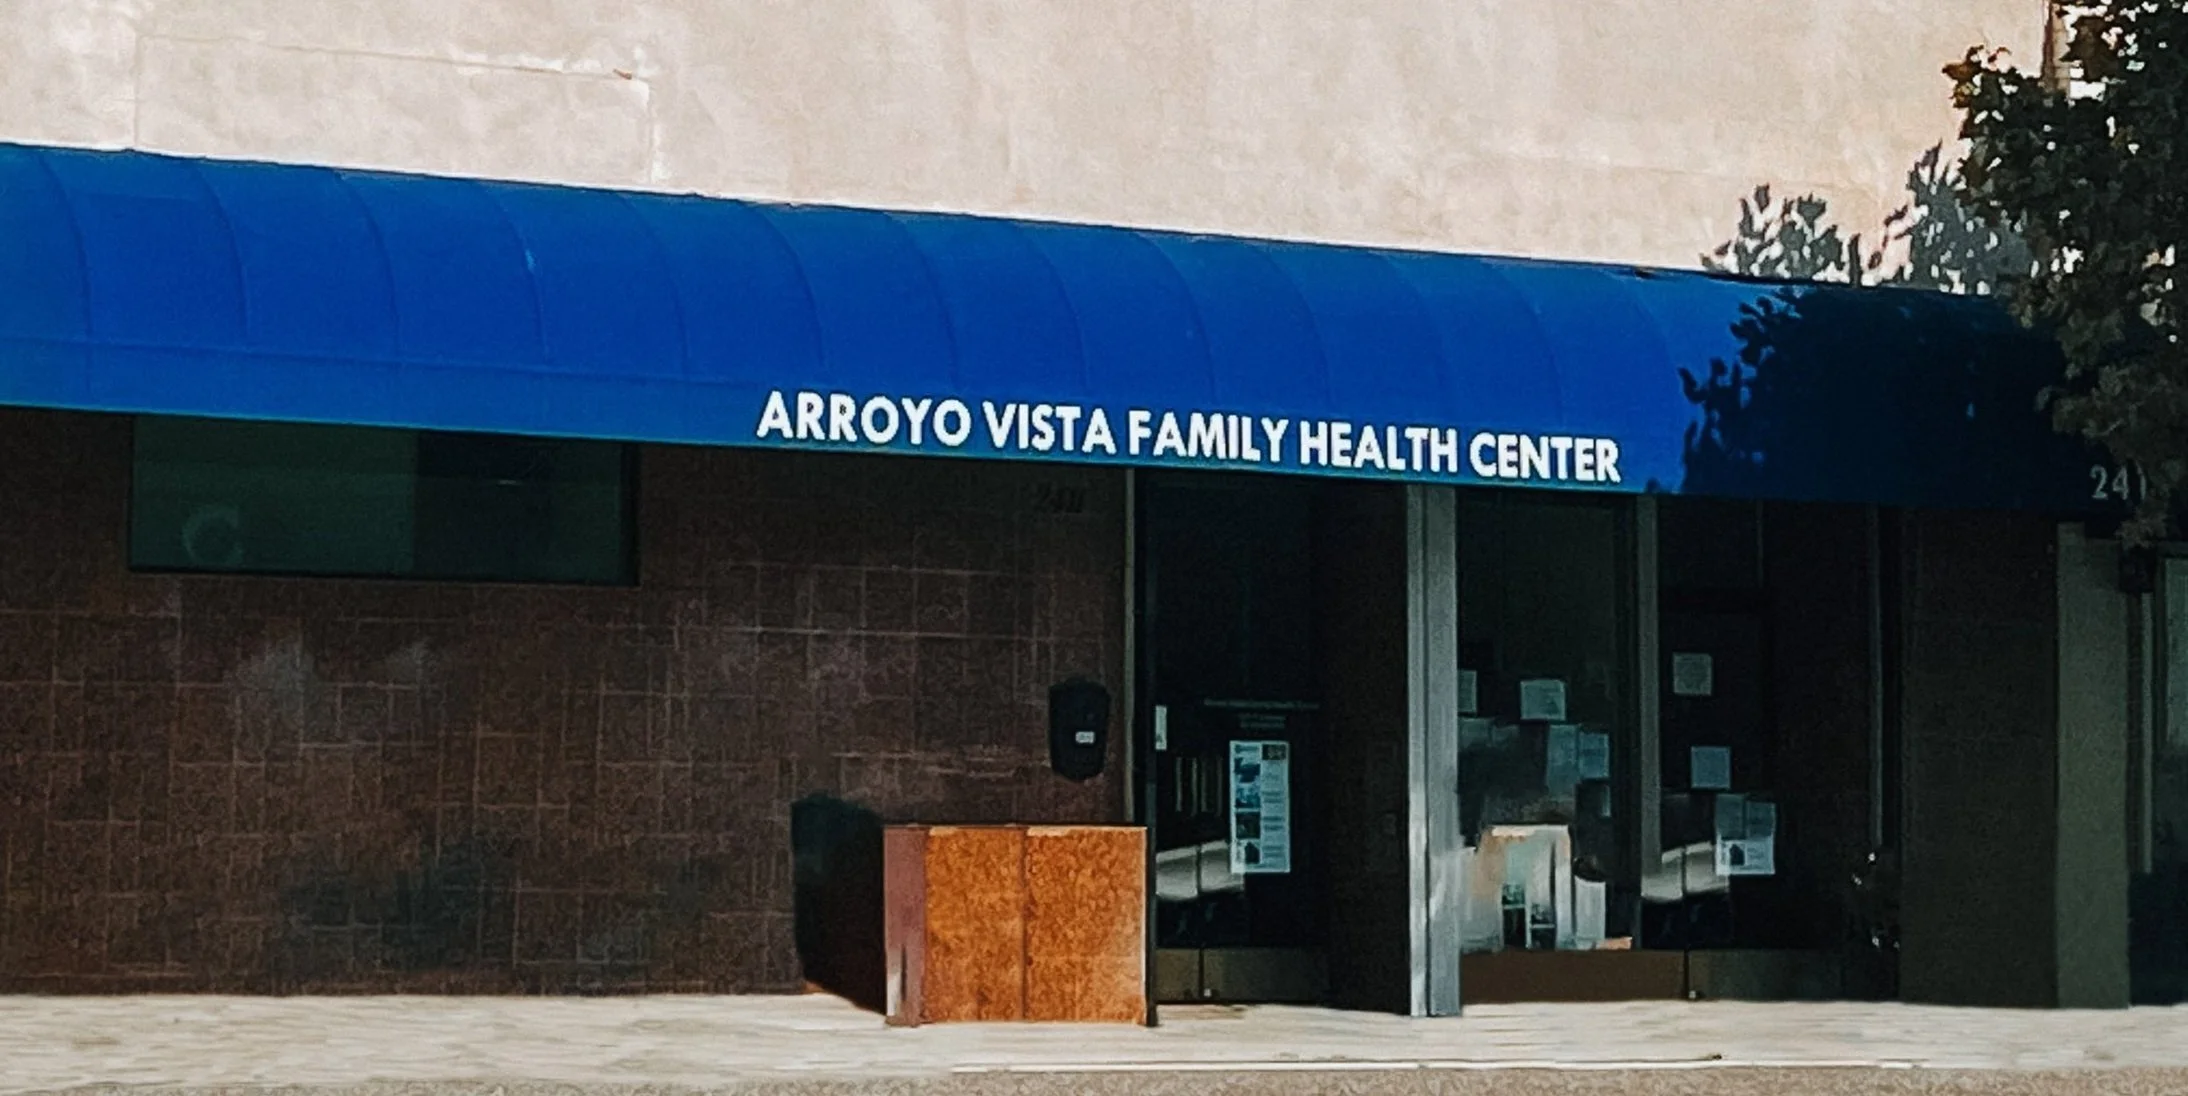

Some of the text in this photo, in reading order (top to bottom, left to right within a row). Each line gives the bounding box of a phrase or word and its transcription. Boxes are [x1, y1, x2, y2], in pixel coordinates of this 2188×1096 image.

[757, 391, 1621, 482] ARROYO VISTA FAMILY HEALTH CENTER
